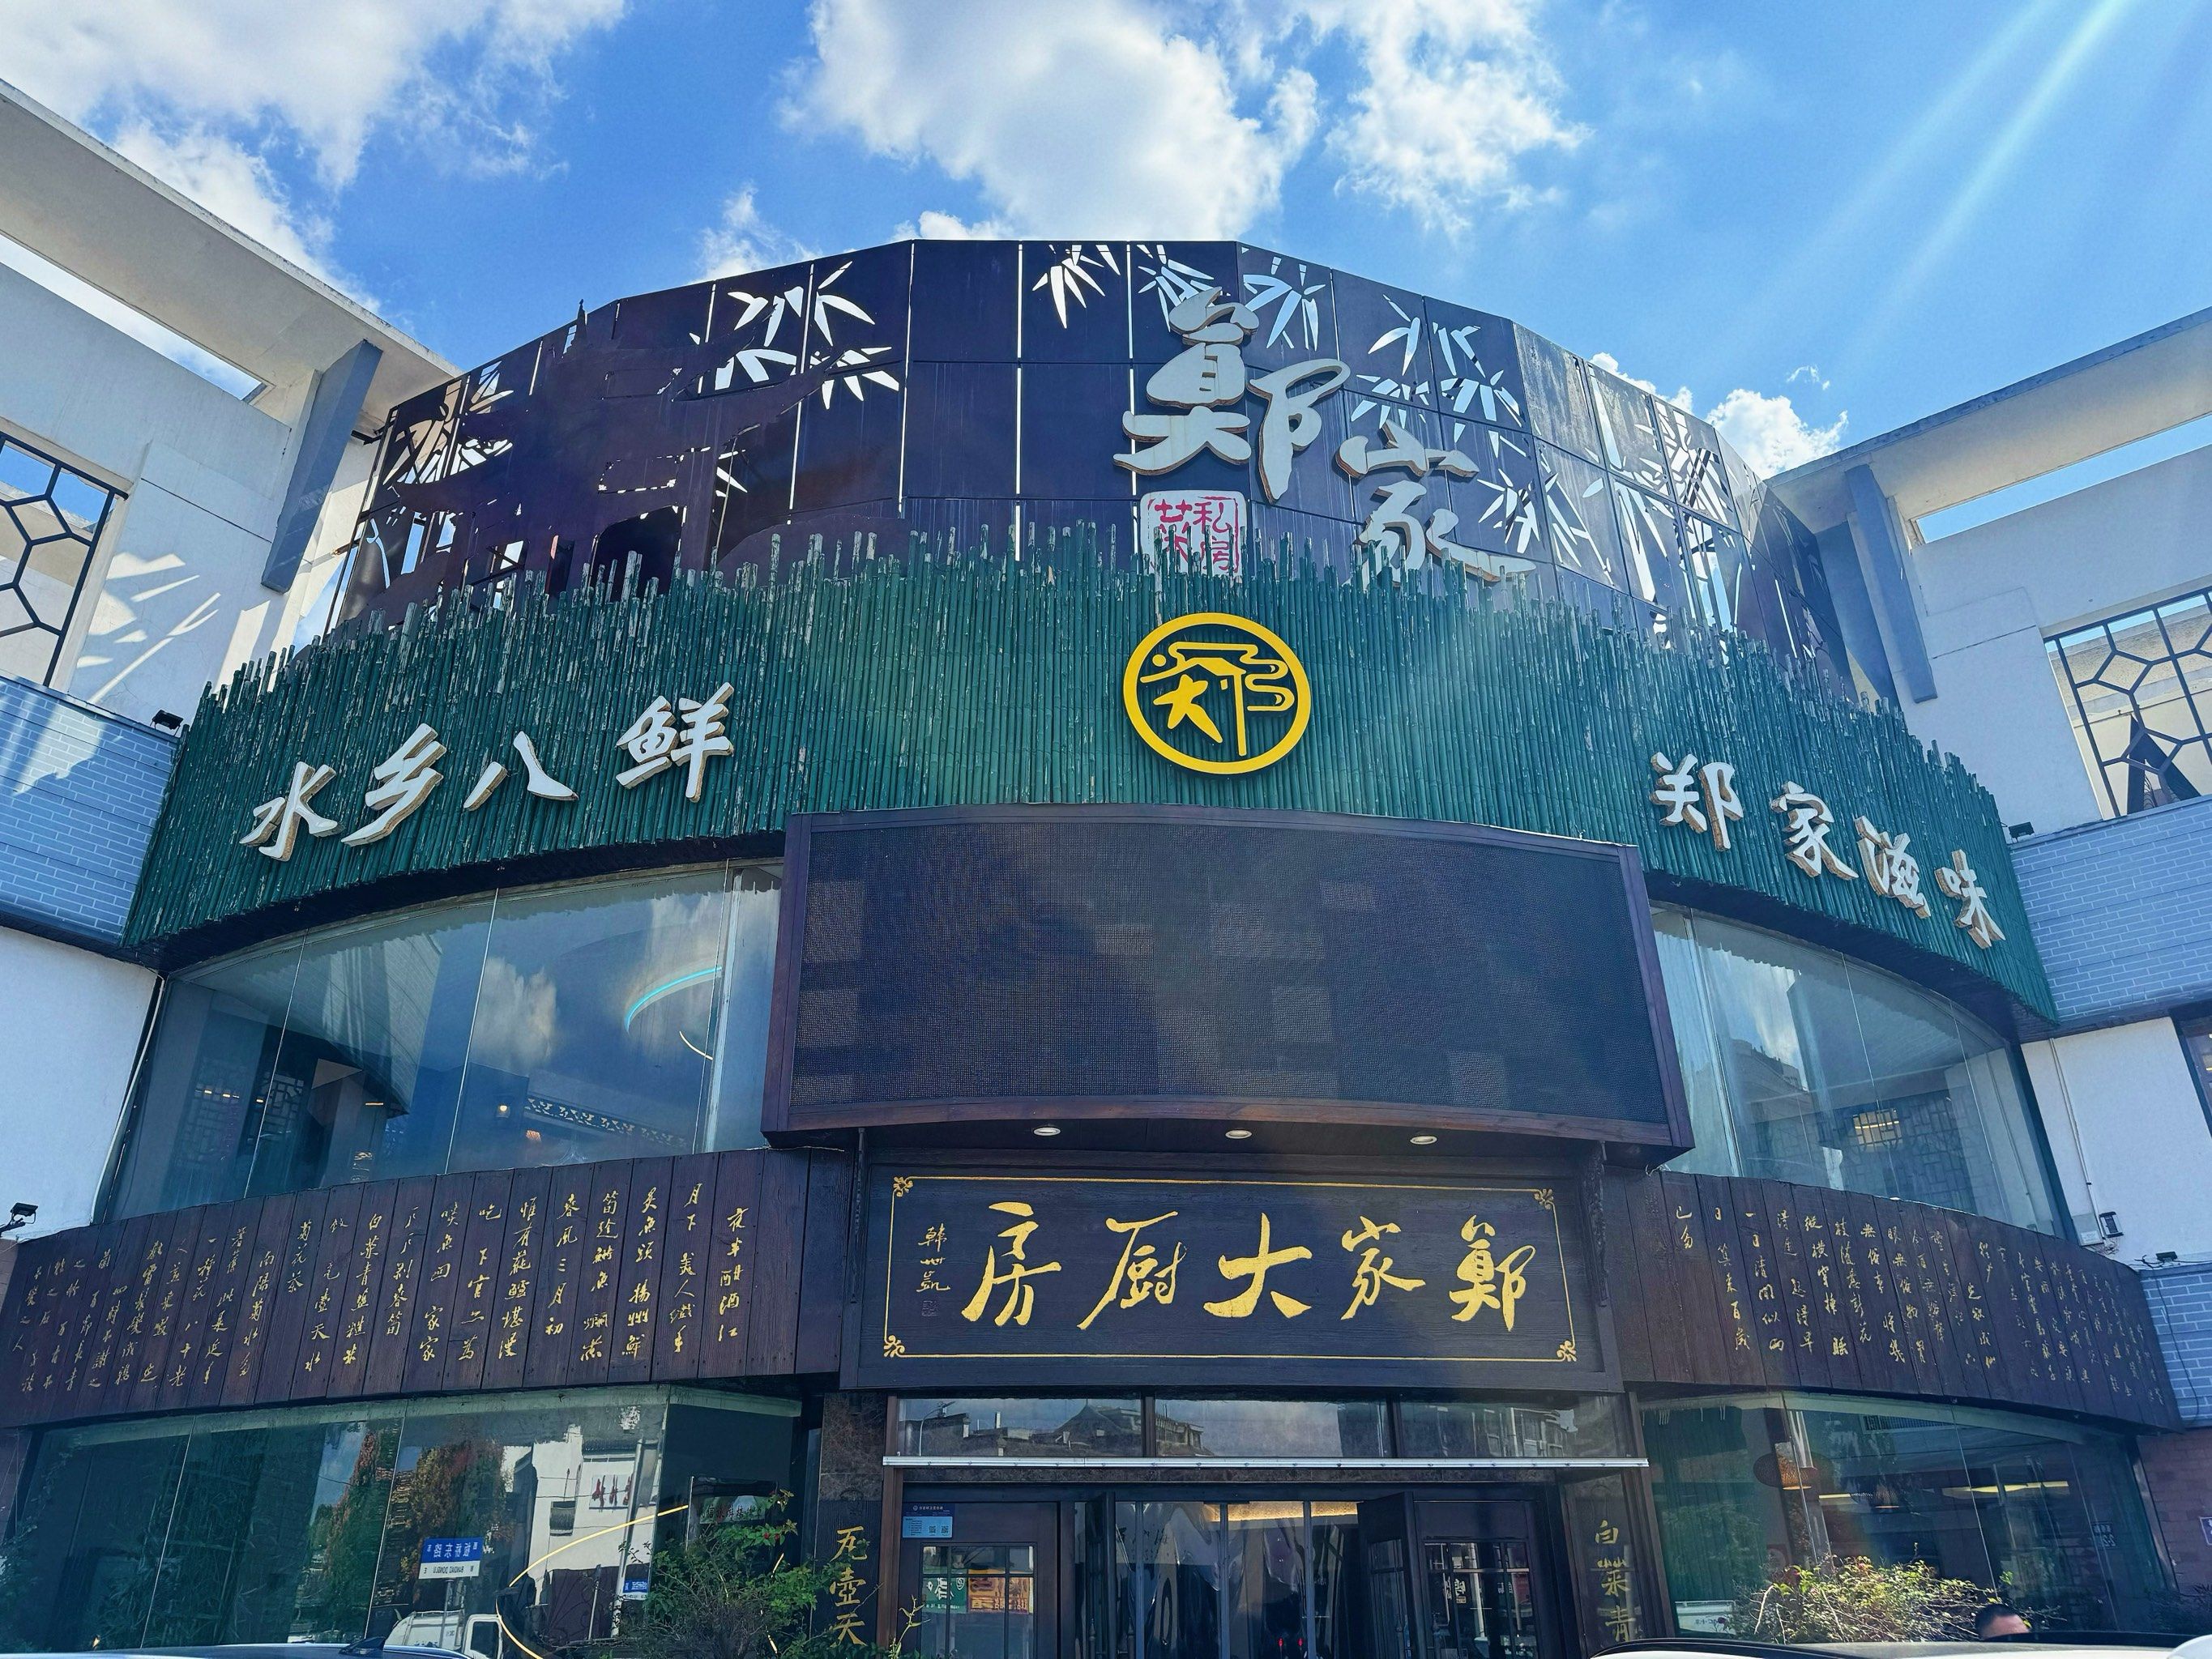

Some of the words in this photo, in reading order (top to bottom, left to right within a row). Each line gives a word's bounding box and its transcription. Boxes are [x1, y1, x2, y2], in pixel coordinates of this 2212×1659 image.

[239, 681, 734, 862] 水乡八鲜
[1650, 751, 2006, 949] 郑家滋味
